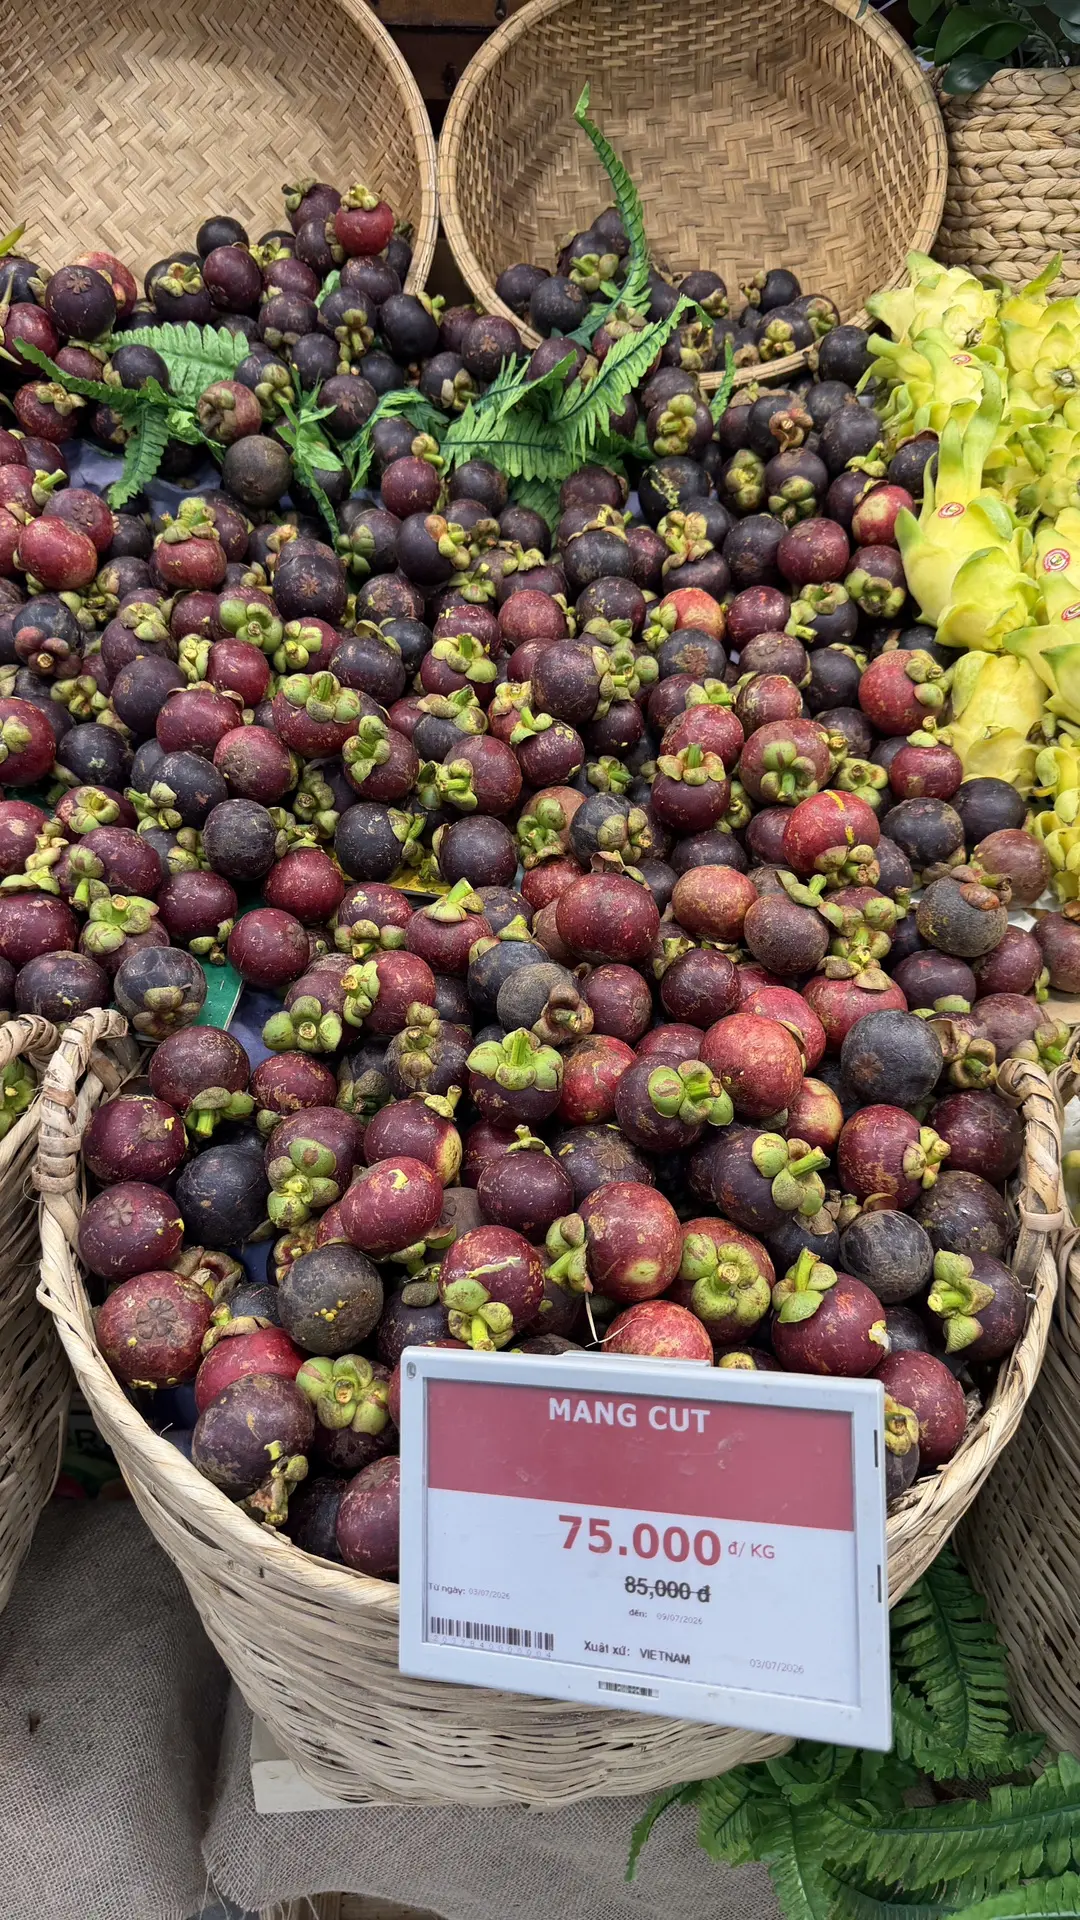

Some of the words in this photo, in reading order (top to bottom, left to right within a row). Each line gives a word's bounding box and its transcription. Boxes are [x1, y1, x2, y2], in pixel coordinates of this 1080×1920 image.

[549, 1398, 637, 1428] MANG
[648, 1406, 711, 1433] CUT
[558, 1514, 721, 1566] 75.000
[751, 1543, 775, 1559] KG
[441, 1585, 466, 1596] ngày:
[468, 1588, 511, 1600] 03/07/2026
[624, 1576, 691, 1599] 85,000
[656, 1612, 703, 1625] 09/07/2026
[584, 1640, 609, 1654] Xuất
[612, 1645, 631, 1657] xứ:
[639, 1648, 691, 1665] VIETNAM
[749, 1658, 805, 1674] 03/07/2026
